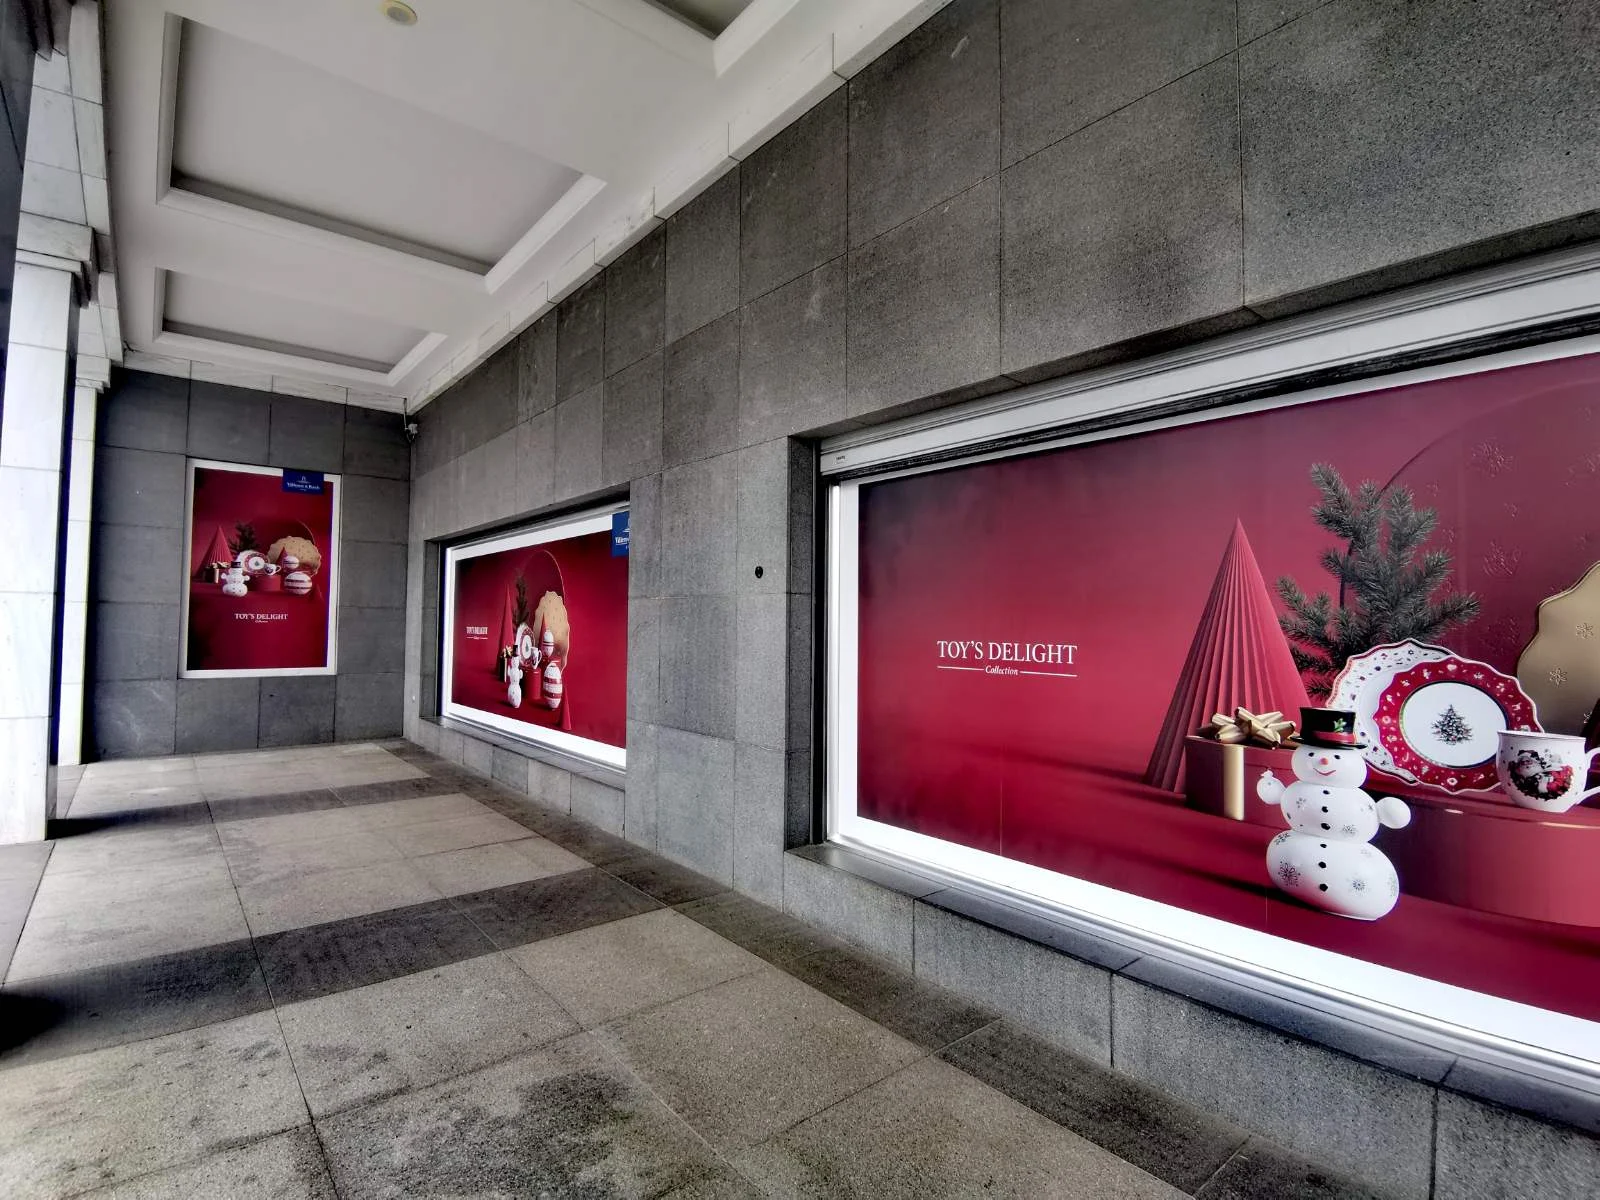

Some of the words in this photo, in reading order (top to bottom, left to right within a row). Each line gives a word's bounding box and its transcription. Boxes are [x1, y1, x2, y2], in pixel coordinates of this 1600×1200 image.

[936, 640, 983, 660] TOY'S
[988, 642, 1078, 664] DELIGHT
[985, 665, 1019, 675] Collection
